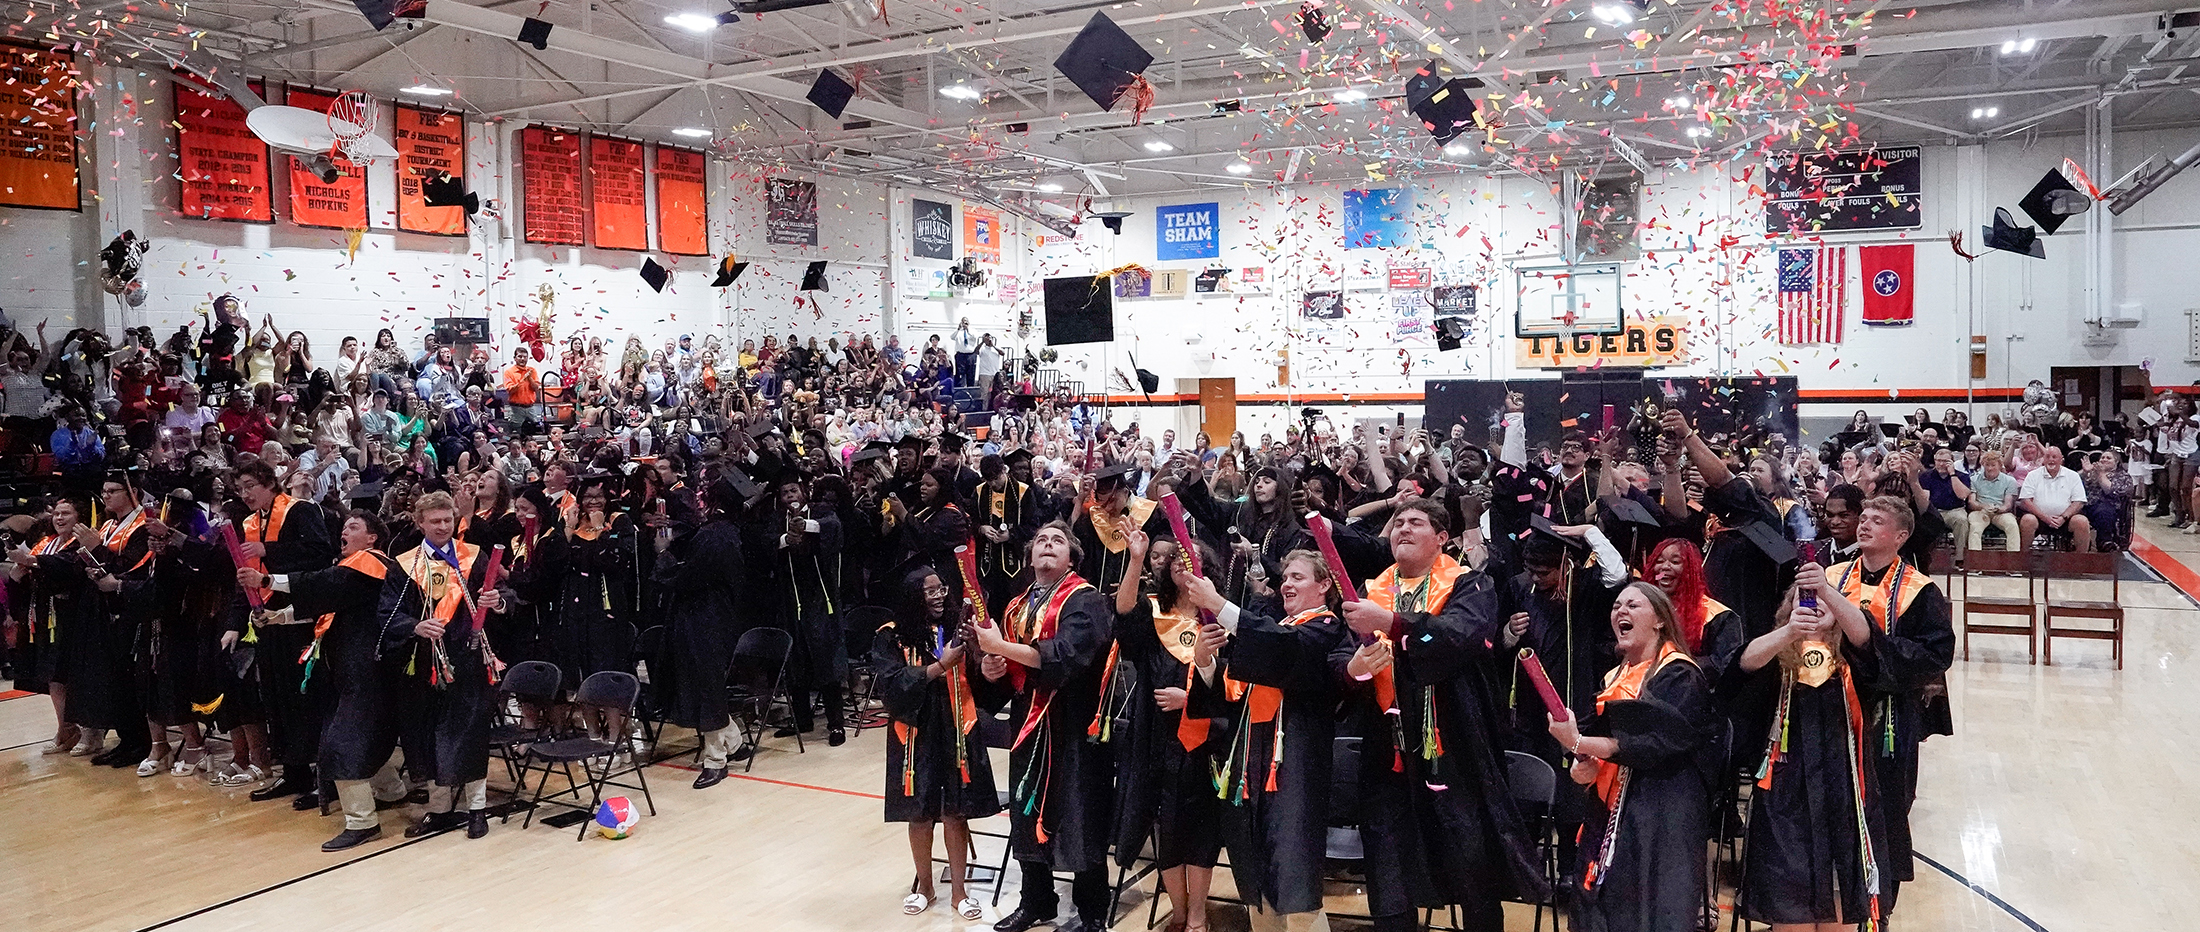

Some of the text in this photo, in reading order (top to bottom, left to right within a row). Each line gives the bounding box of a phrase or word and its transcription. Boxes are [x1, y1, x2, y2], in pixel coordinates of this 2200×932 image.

[0, 69, 42, 84] ENNIS
[189, 147, 258, 162] STATE CHAMPION
[414, 145, 444, 156] DISTRICT
[1881, 149, 1919, 160] VISITOR
[198, 161, 220, 172] 2012
[231, 164, 252, 174] 2013
[407, 155, 451, 168] TOURNAMENT
[189, 181, 213, 191] STATE
[402, 177, 418, 187] 2018
[305, 186, 350, 200] NICHOLAS
[1881, 184, 1905, 193] BONUS
[200, 193, 220, 203] 2014
[233, 196, 253, 206] 2015
[308, 199, 349, 212] HOPKINS
[1819, 198, 1871, 208] PLAYER FOULS
[1885, 196, 1908, 204] FULS
[1778, 202, 1799, 210] FOULS
[1164, 211, 1210, 227] TEAM
[917, 219, 951, 241] WHISKEY
[1164, 227, 1212, 242] SHAM
[1045, 234, 1084, 243] REDSTNE
[1391, 295, 1426, 307] LEVEL
[1436, 297, 1474, 307] MARKET
[1402, 306, 1420, 317] UP
[1397, 318, 1421, 327] FIRST
[1528, 327, 1675, 356] TIGERS
[967, 588, 986, 622] Confetti
